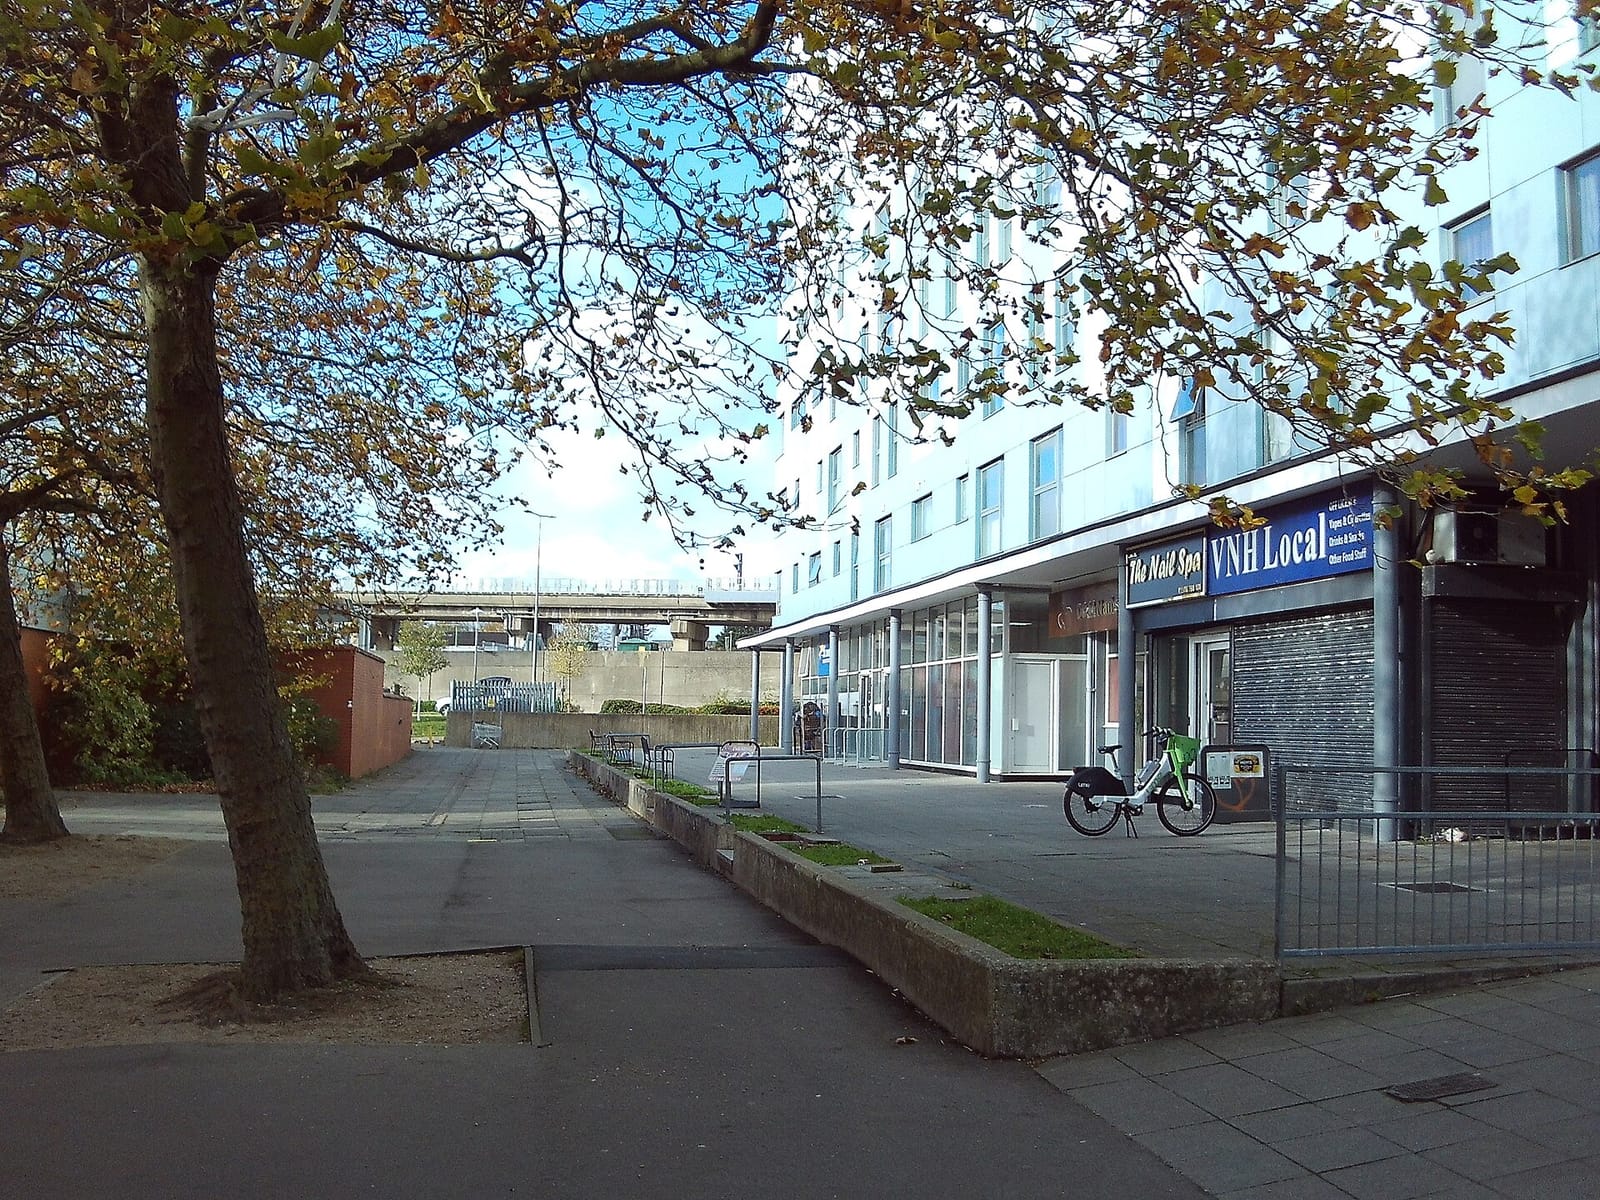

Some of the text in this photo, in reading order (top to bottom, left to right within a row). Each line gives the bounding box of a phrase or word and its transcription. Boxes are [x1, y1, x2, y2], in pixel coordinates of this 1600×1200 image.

[1328, 519, 1342, 531] Vapes
[1342, 515, 1347, 526] &
[1210, 511, 1327, 580] VNH Local
[1328, 535, 1343, 547] Drinks
[1343, 533, 1348, 544] &
[1328, 547, 1367, 565] Other Food Stuff
[1129, 547, 1201, 585] The Nail Spa
